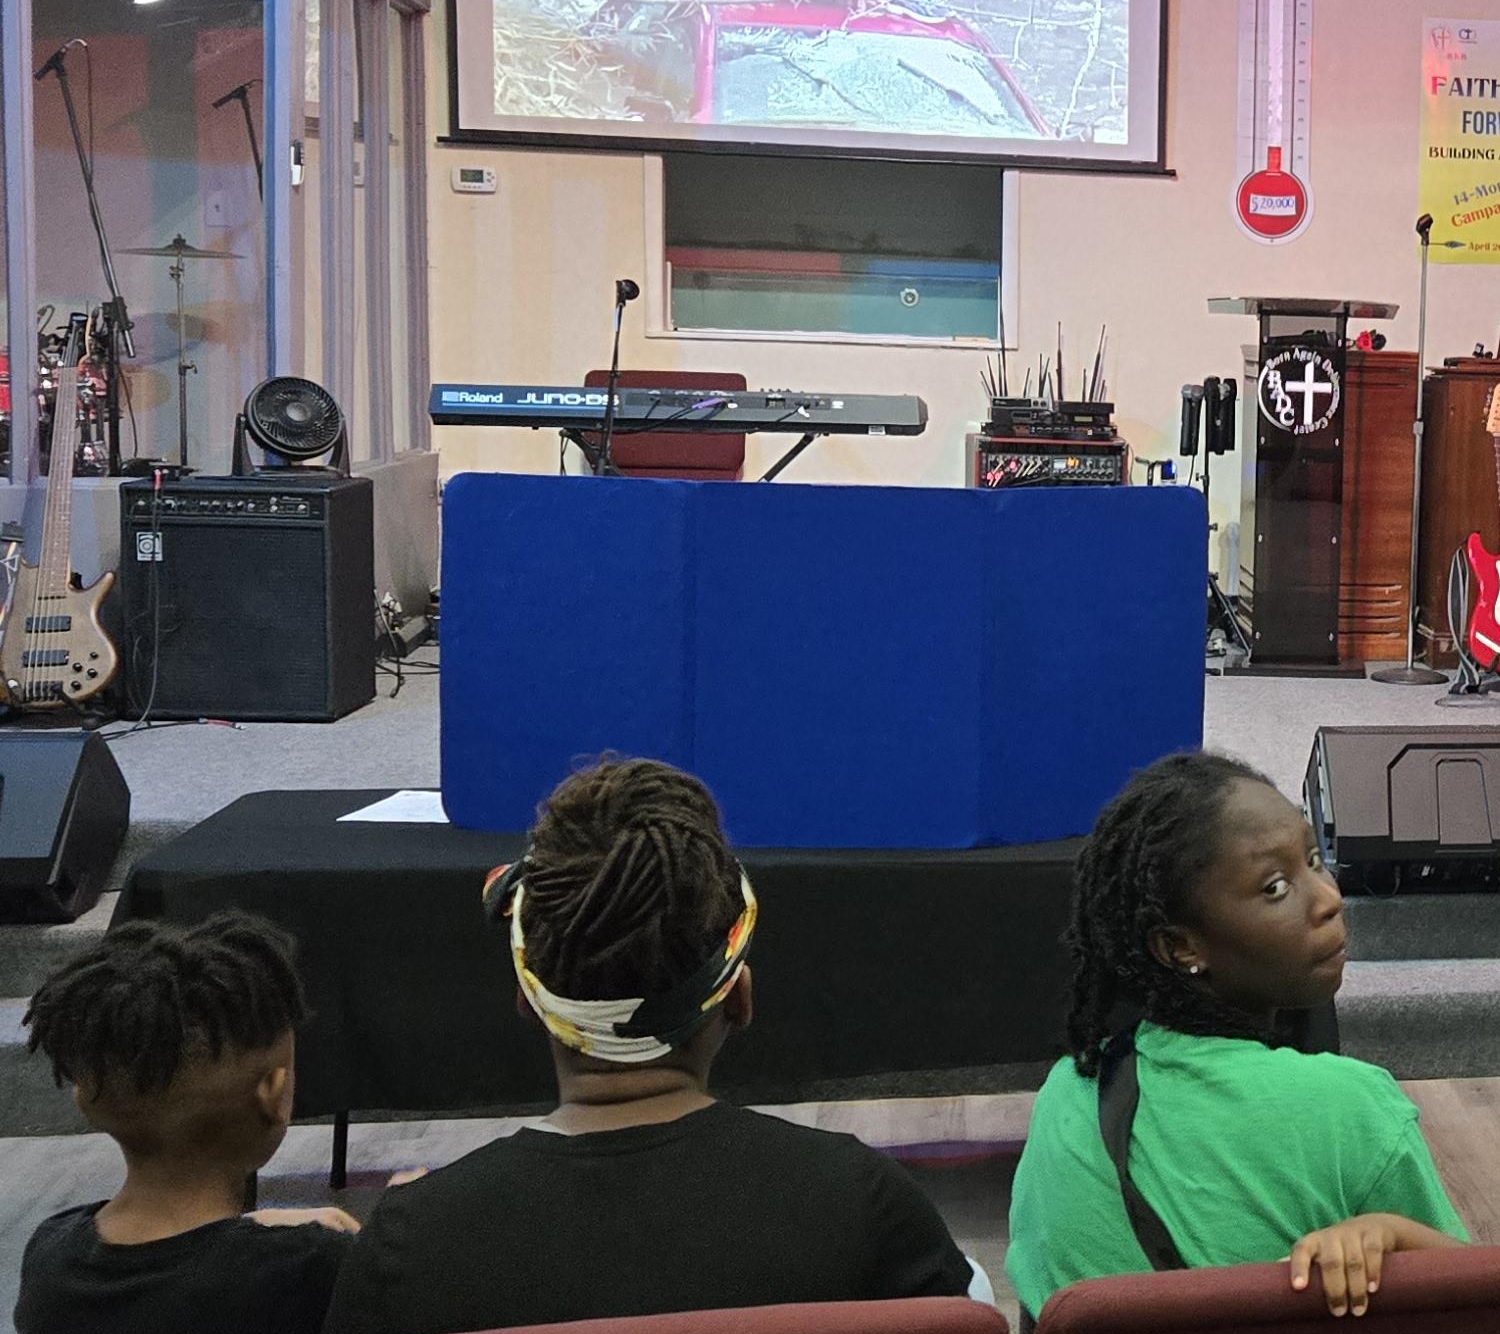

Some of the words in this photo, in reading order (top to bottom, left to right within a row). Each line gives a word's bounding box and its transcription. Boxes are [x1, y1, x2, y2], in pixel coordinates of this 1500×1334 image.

[1429, 146, 1495, 160] BUILDING
[1468, 241, 1491, 252] April
[459, 391, 504, 404] Roland
